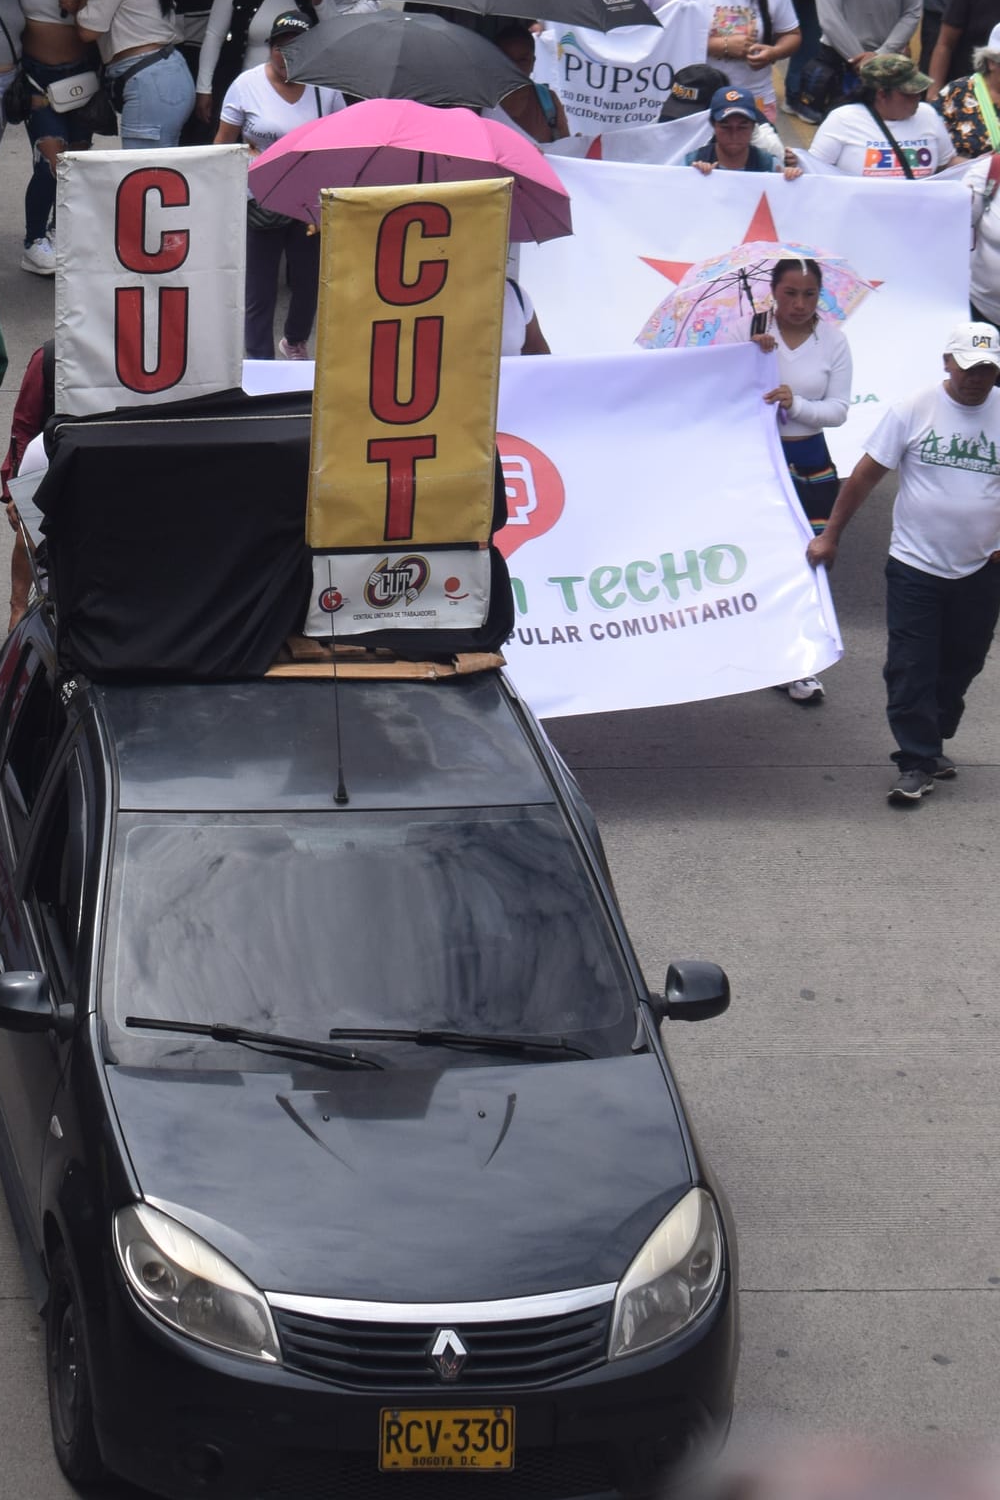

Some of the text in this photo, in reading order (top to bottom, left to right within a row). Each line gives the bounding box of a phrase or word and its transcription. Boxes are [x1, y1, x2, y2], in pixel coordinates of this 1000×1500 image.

[563, 51, 675, 94] PUPSO
[638, 96, 664, 109] POP
[623, 112, 657, 123] COLO
[866, 138, 929, 148] PRESDENTE
[863, 147, 932, 169] PERO
[113, 166, 190, 395] CU
[971, 335, 992, 349] CAT
[366, 201, 452, 542] CUT
[401, 609, 437, 618] TRABAJADORES
[588, 591, 759, 640] COMUNITARIO
[411, 1455, 481, 1466] BOGOTA D.C.
